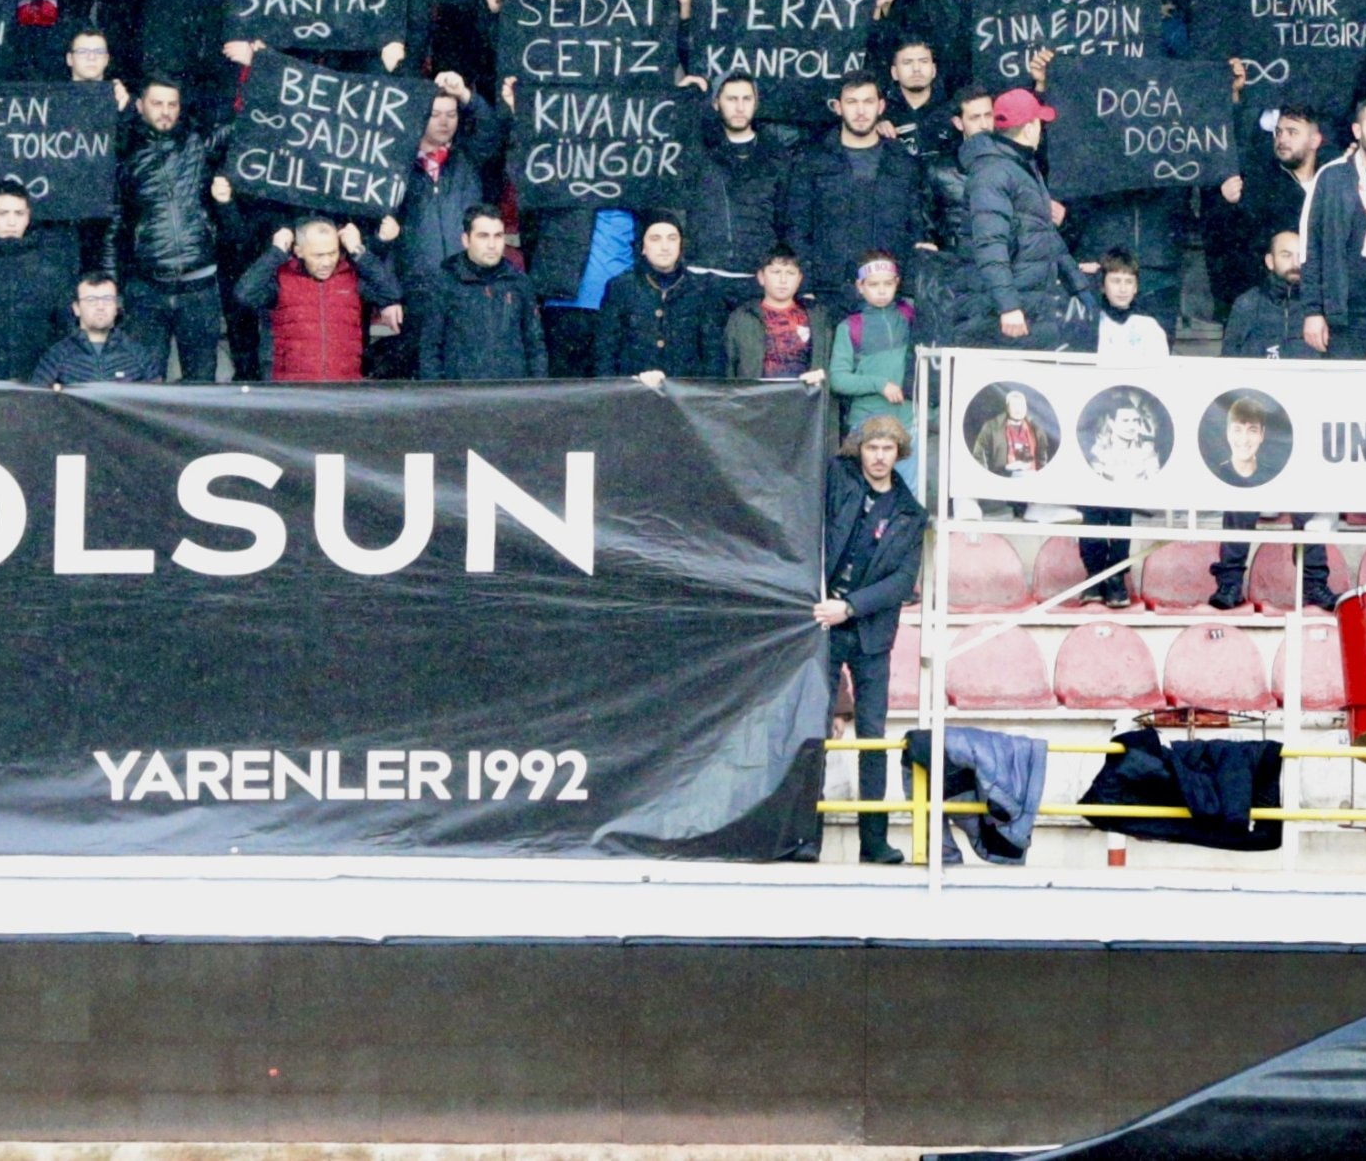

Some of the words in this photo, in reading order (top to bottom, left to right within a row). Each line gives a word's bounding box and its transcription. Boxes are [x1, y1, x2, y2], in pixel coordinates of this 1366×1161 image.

[520, 37, 661, 83] ÇETİZ
[279, 66, 410, 132] BEKİR
[532, 85, 677, 144] KIVANÇ
[1096, 81, 1184, 120] DOĞA
[7, 132, 111, 162] TOKCAN
[285, 112, 396, 169] SADIK
[524, 137, 683, 184] GÜNGÖR
[1124, 121, 1228, 157] DOĞAN
[93, 749, 452, 803] YARENLER
[466, 748, 589, 802] 1992
